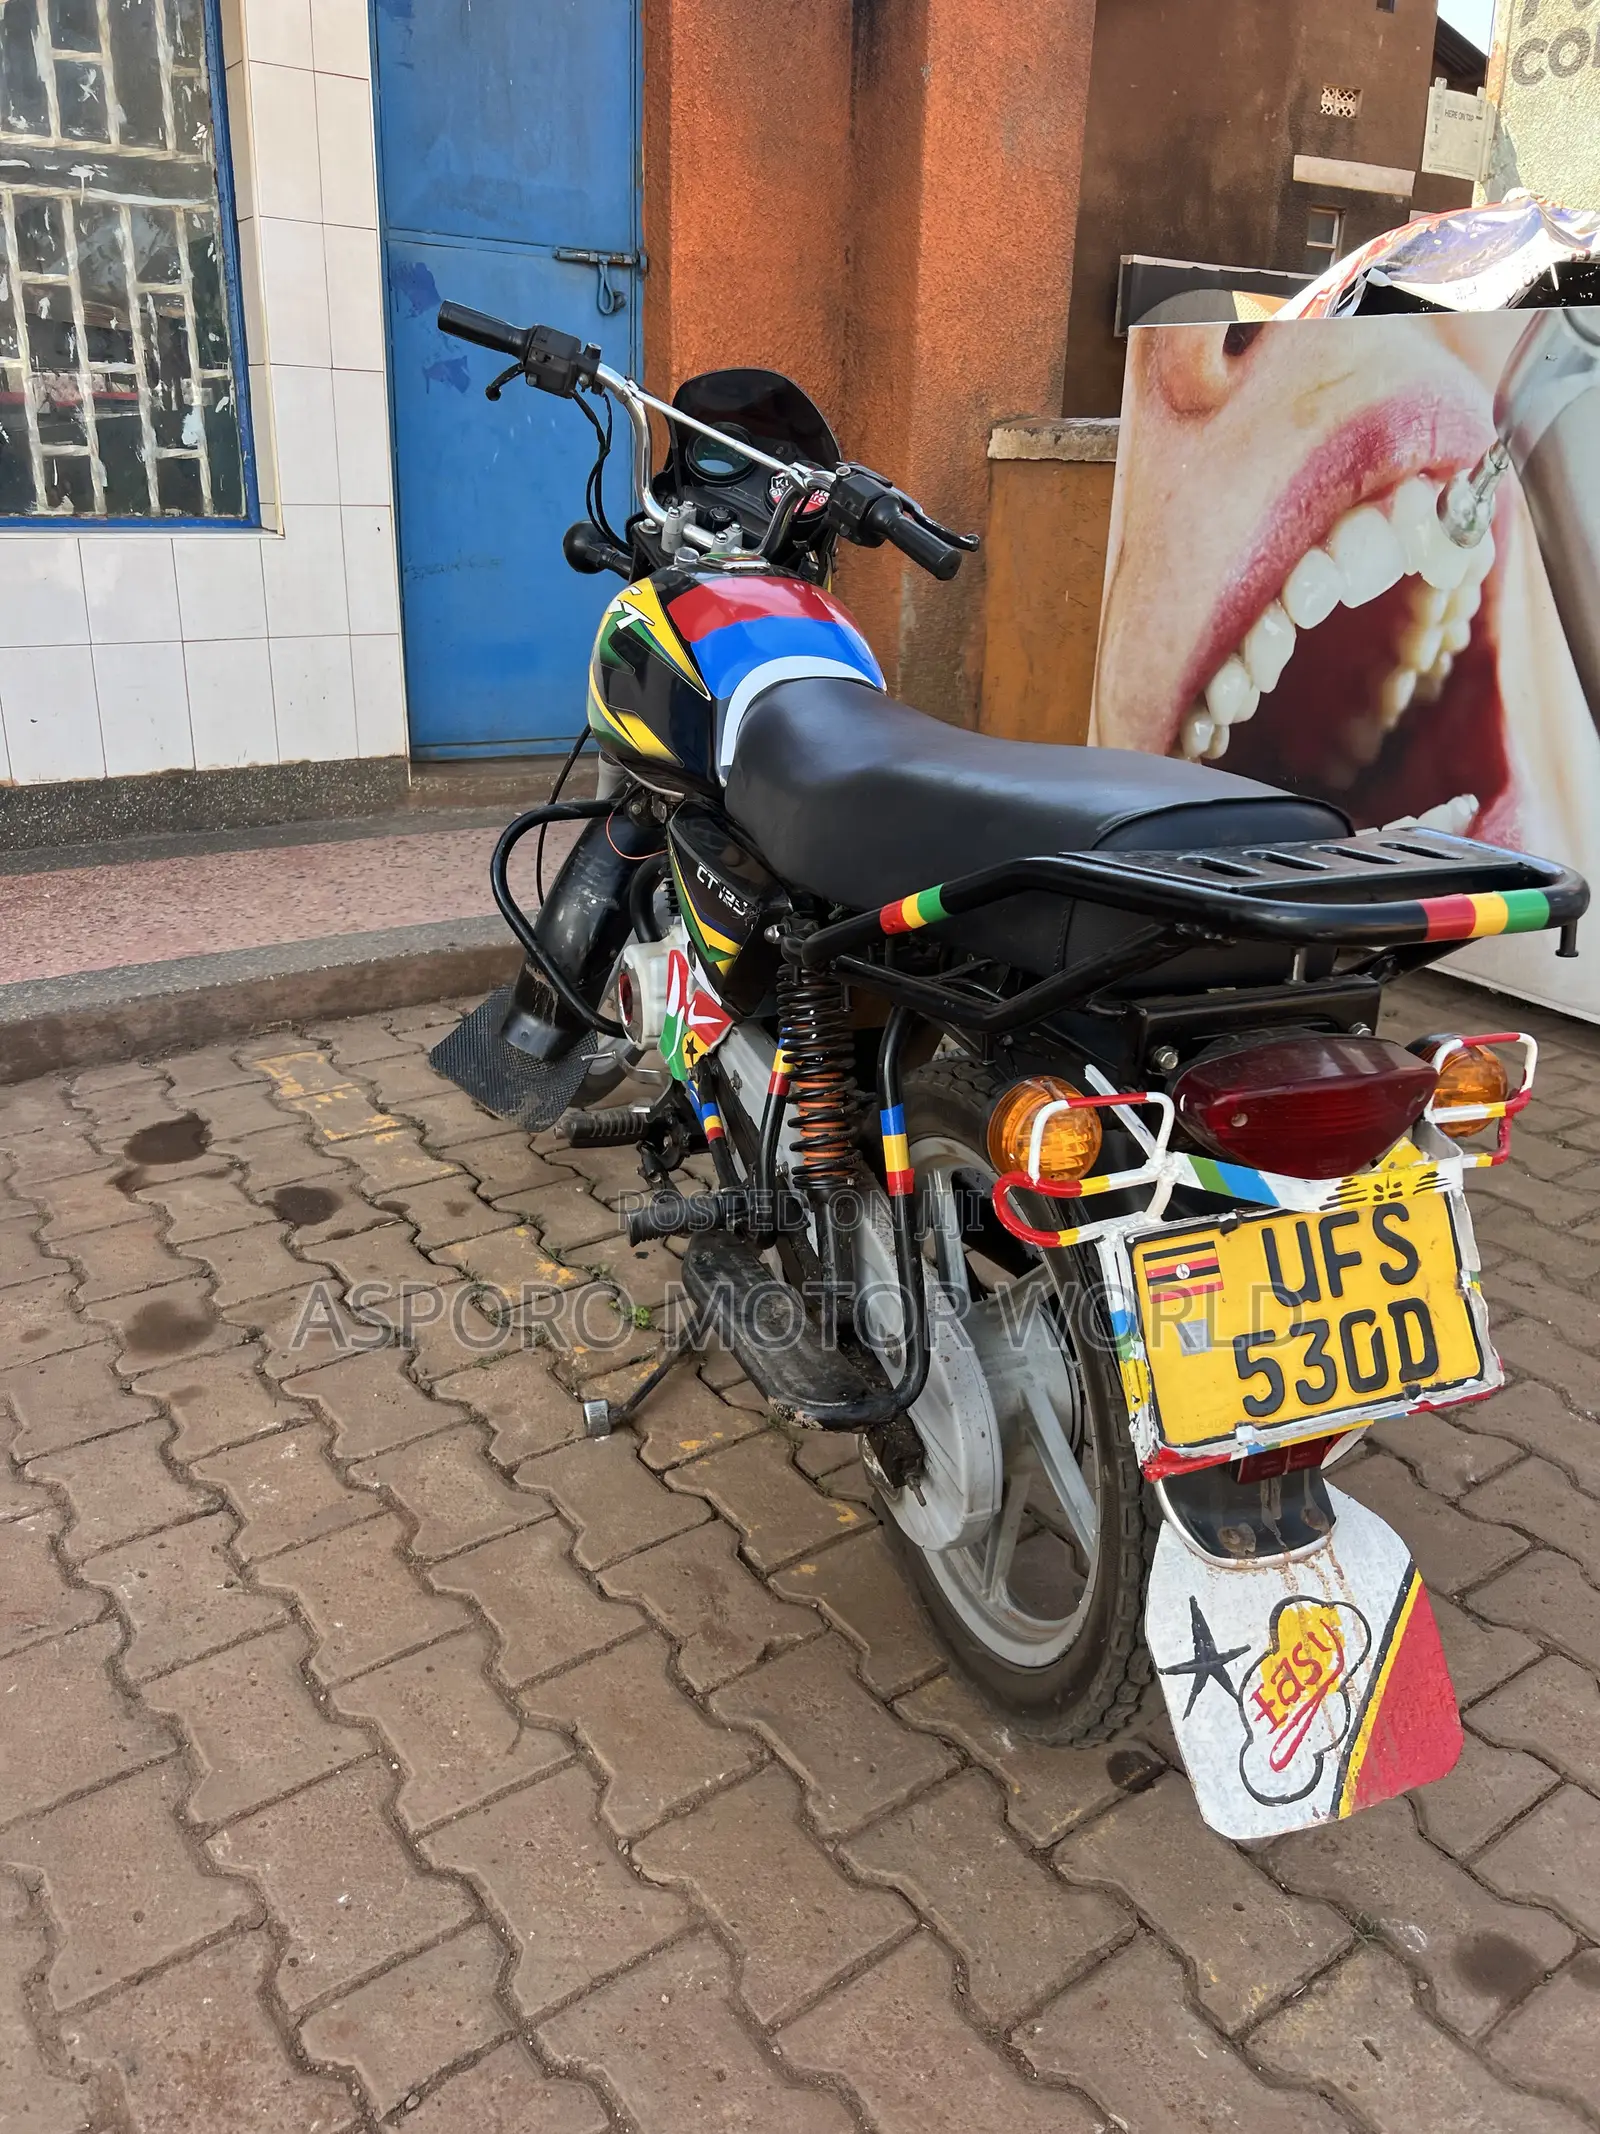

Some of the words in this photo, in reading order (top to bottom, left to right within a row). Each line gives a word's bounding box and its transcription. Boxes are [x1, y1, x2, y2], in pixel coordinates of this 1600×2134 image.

[1511, 26, 1600, 87] CO
[696, 863, 718, 889] CT
[1261, 1203, 1420, 1307] UFS
[1233, 1297, 1440, 1417] 530D
